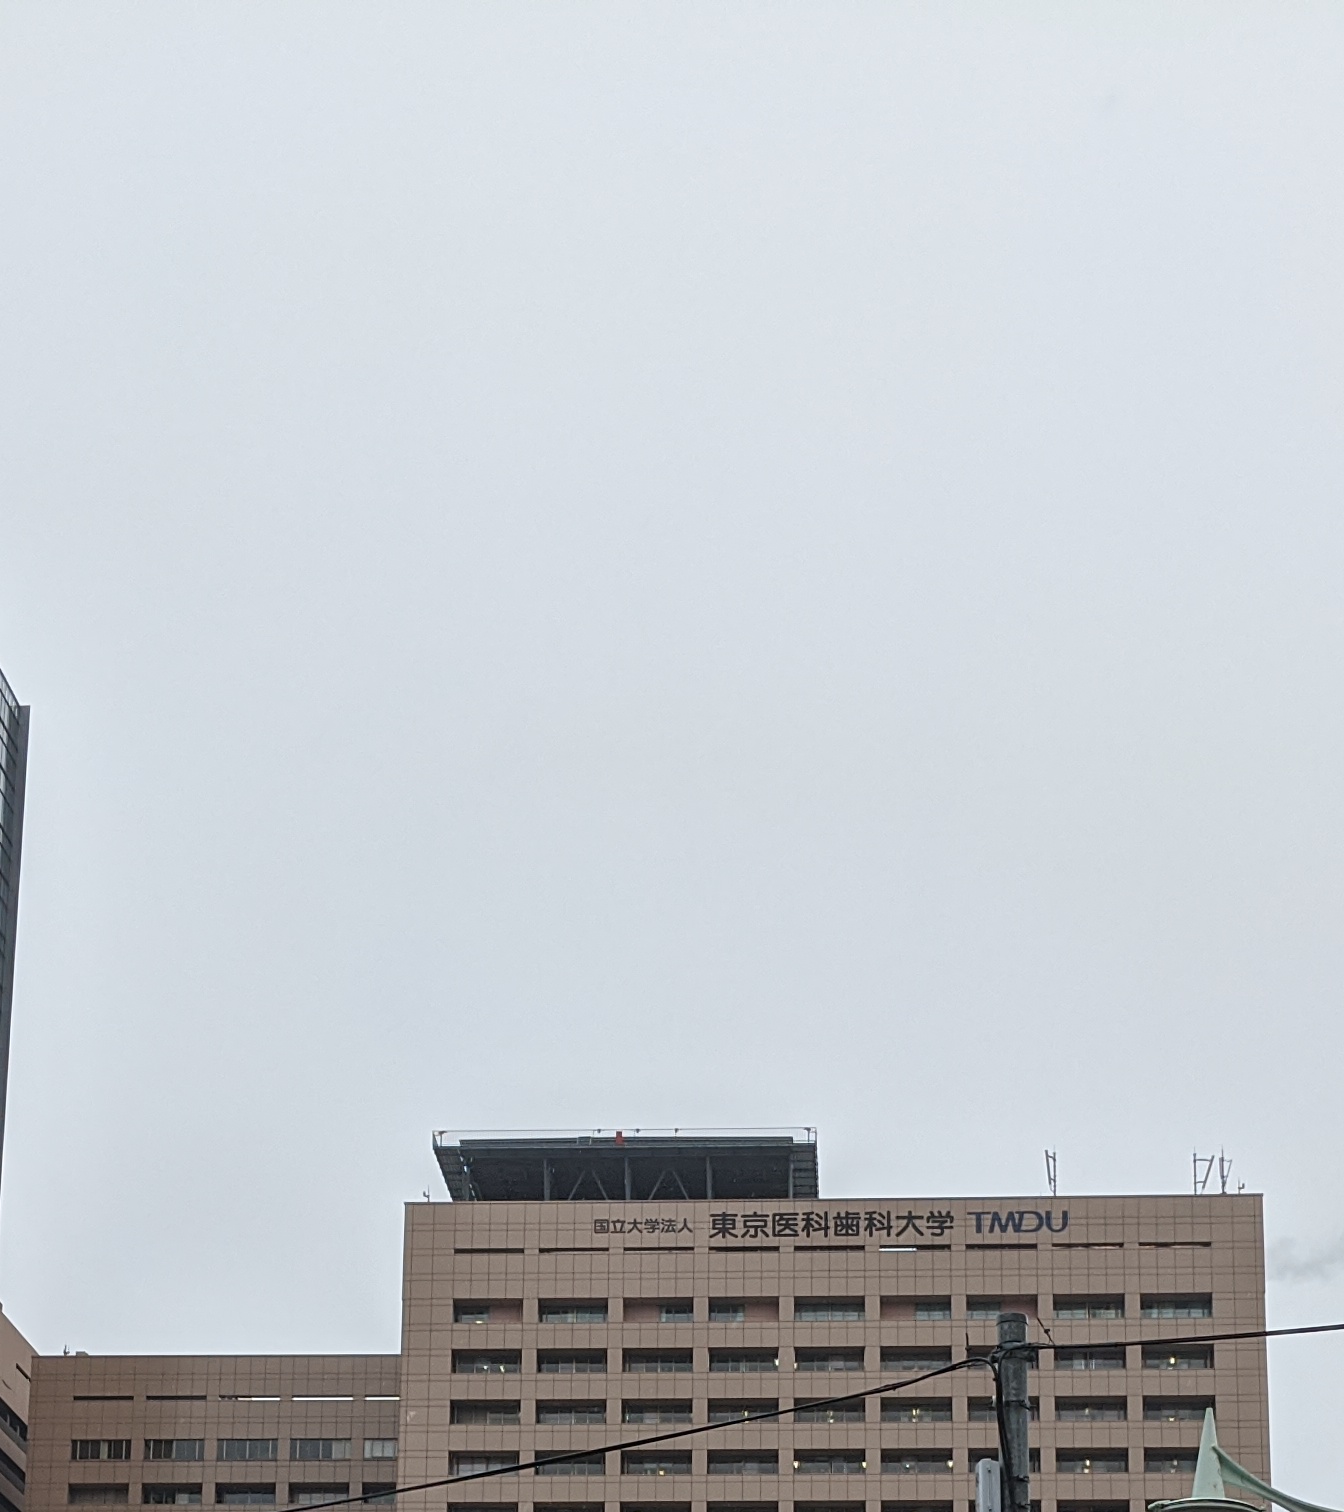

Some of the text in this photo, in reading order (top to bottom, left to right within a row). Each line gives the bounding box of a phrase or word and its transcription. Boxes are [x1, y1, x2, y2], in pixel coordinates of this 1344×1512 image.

[593, 1210, 1070, 1239] 国立大学法人 東京医科歯科大学 TMDU
